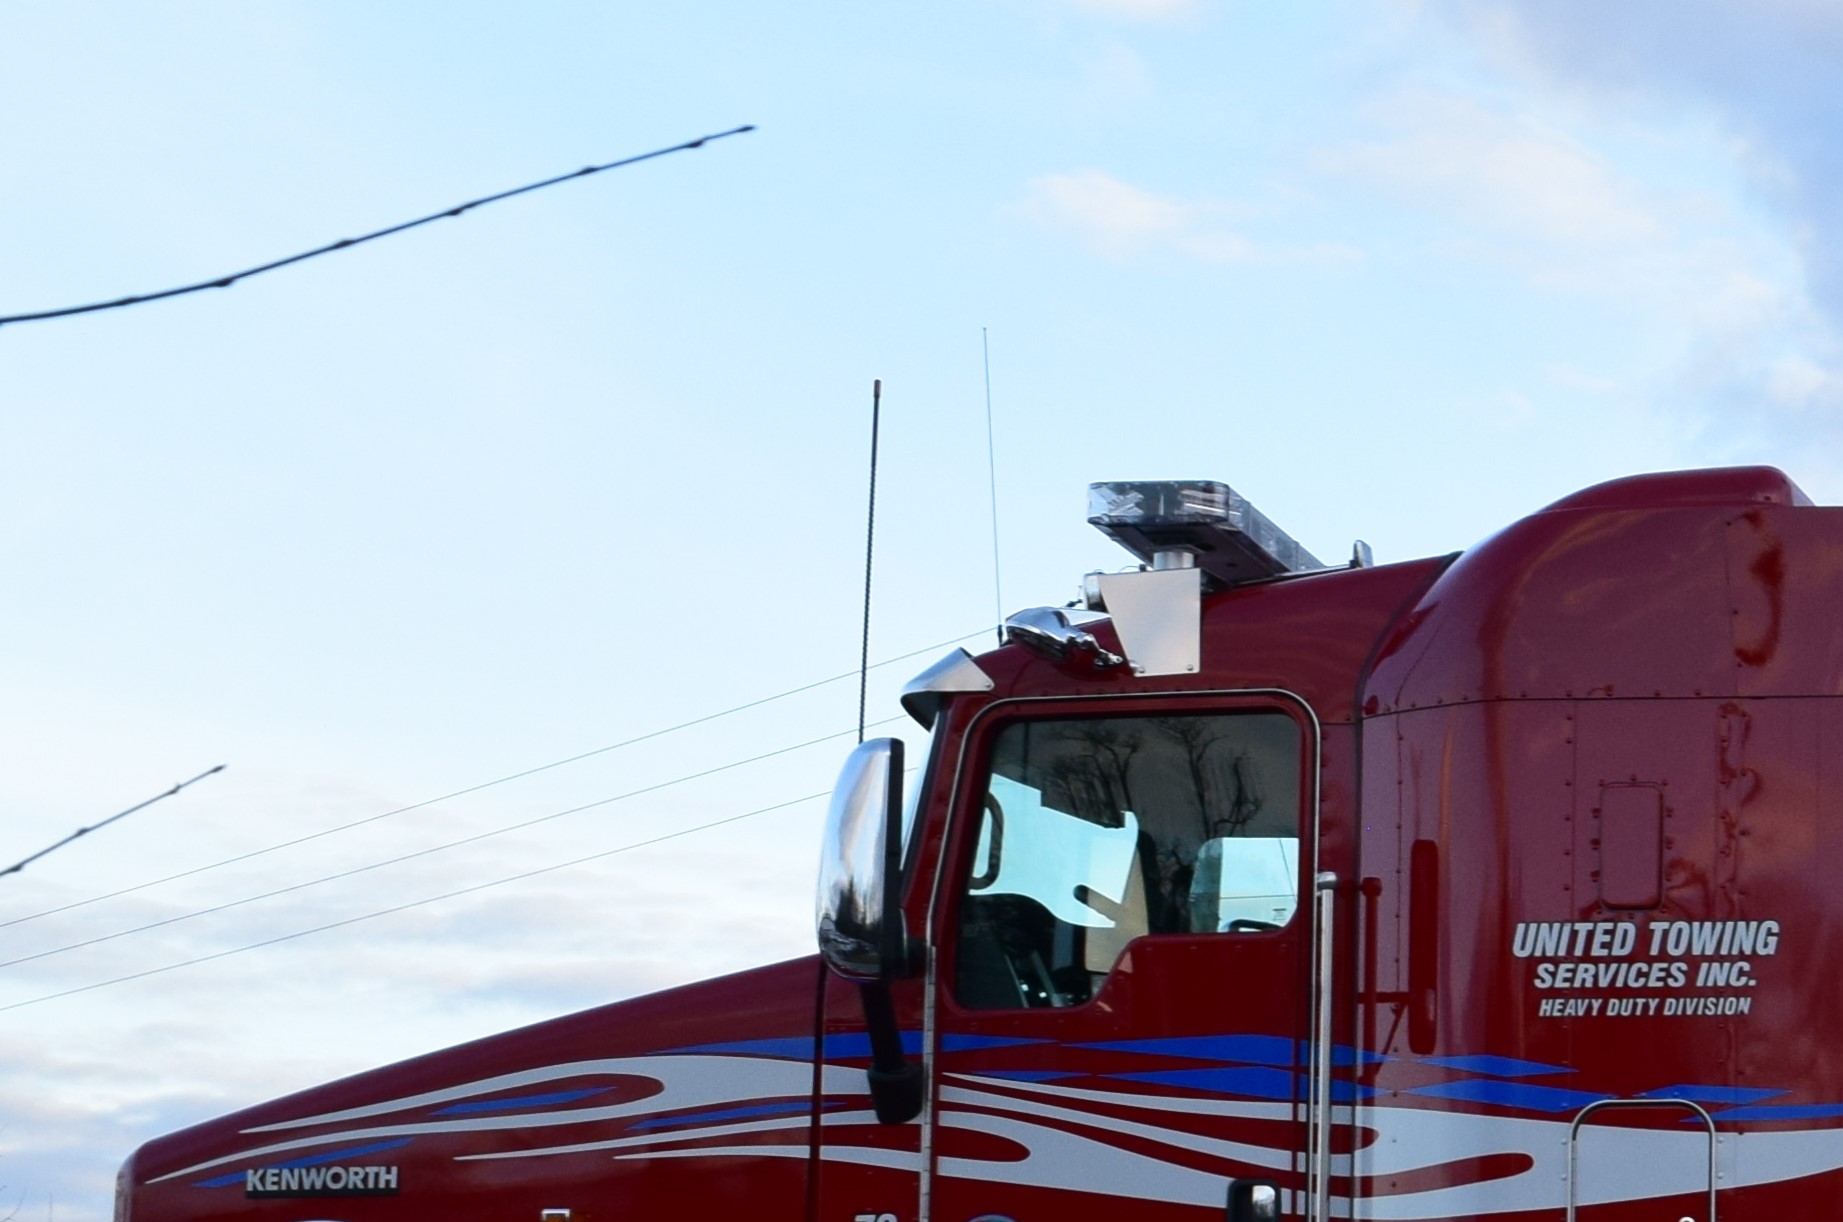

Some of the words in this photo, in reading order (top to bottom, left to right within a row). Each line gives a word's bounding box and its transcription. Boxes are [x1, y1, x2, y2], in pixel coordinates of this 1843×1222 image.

[1512, 922, 1636, 958] UNITED
[1649, 920, 1780, 956] TOWING
[1534, 962, 1688, 989] SERVICES
[1696, 961, 1757, 987] INC.
[1539, 998, 1603, 1017] HEAVY
[1606, 998, 1660, 1017] DUTY
[1663, 996, 1752, 1016] DIVISION
[246, 1166, 398, 1192] KENWORTH
